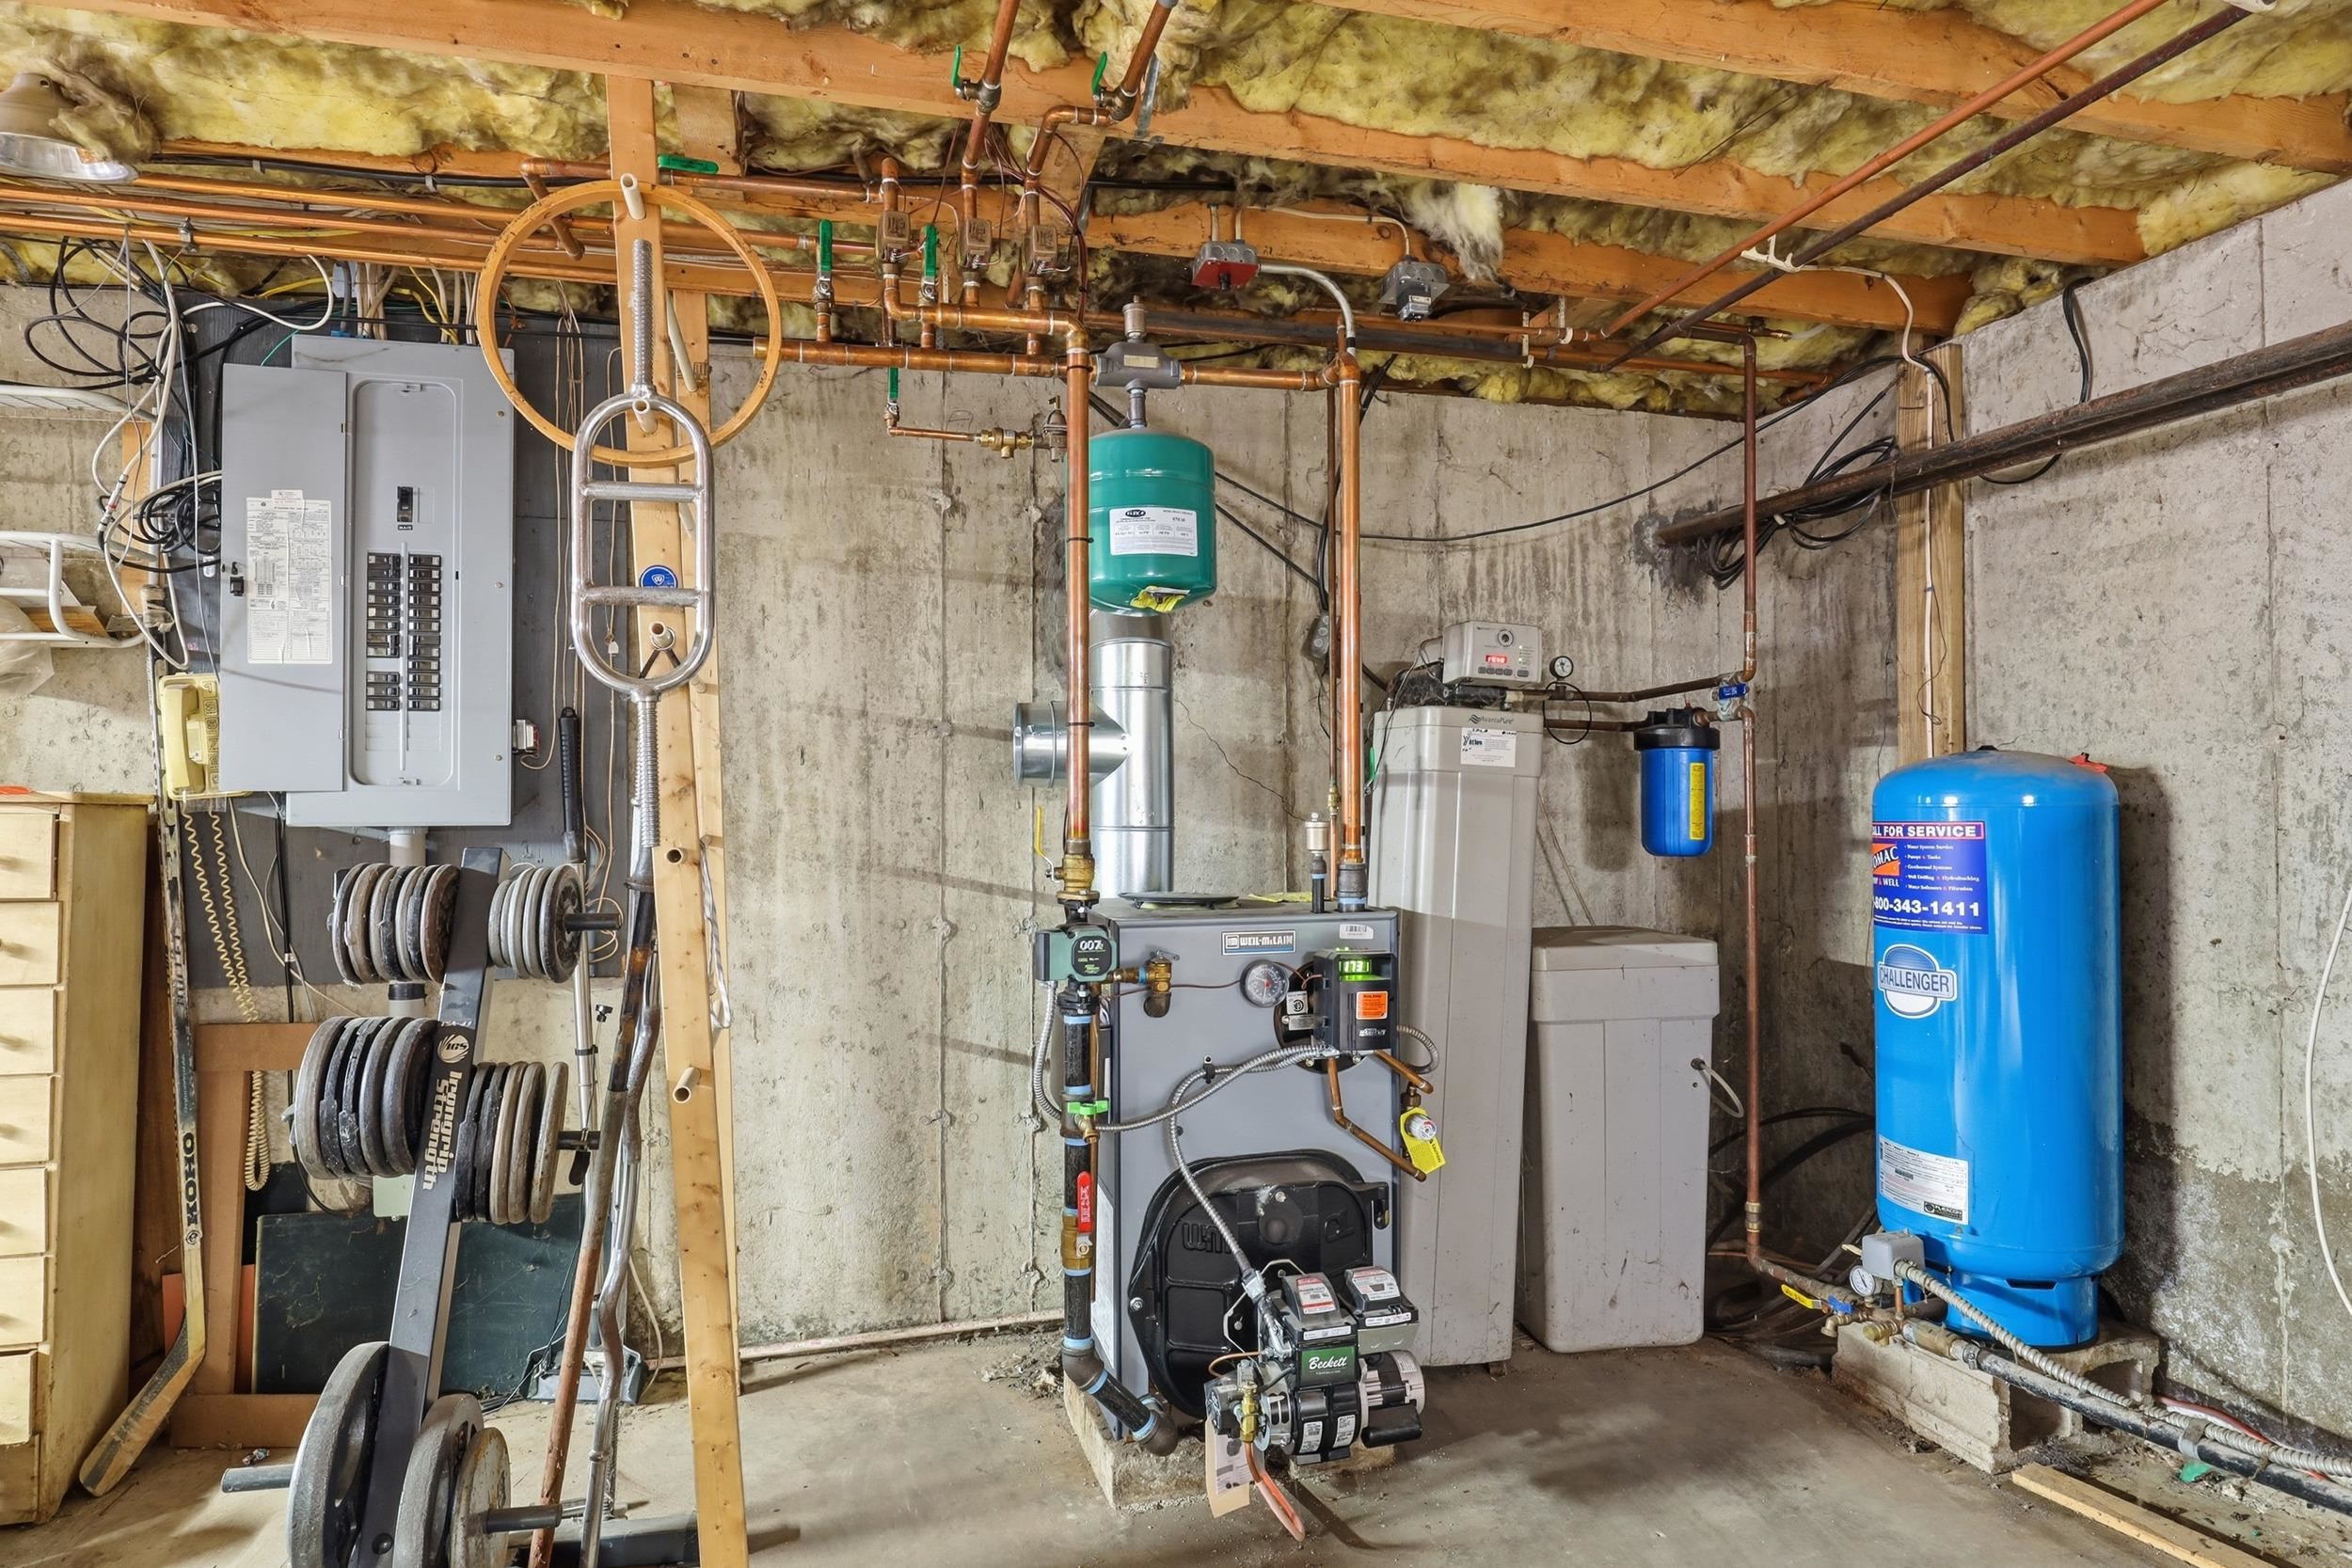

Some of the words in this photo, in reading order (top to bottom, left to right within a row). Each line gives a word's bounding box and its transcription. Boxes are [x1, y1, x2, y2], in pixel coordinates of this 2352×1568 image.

[1883, 826, 1904, 837] FOR
[1907, 825, 1977, 837] SERVICE
[1873, 846, 1899, 869] OMAC
[1883, 878, 1899, 887] WELL
[1873, 896, 1979, 916] -800-343-1411
[1343, 959, 1364, 973] 173
[1879, 966, 1949, 993] CHALLENGER
[437, 1070, 463, 1174] Irongrip
[422, 1078, 449, 1191] Strength
[183, 1132, 198, 1227] KOHO
[1309, 1354, 1348, 1370] Beckett
